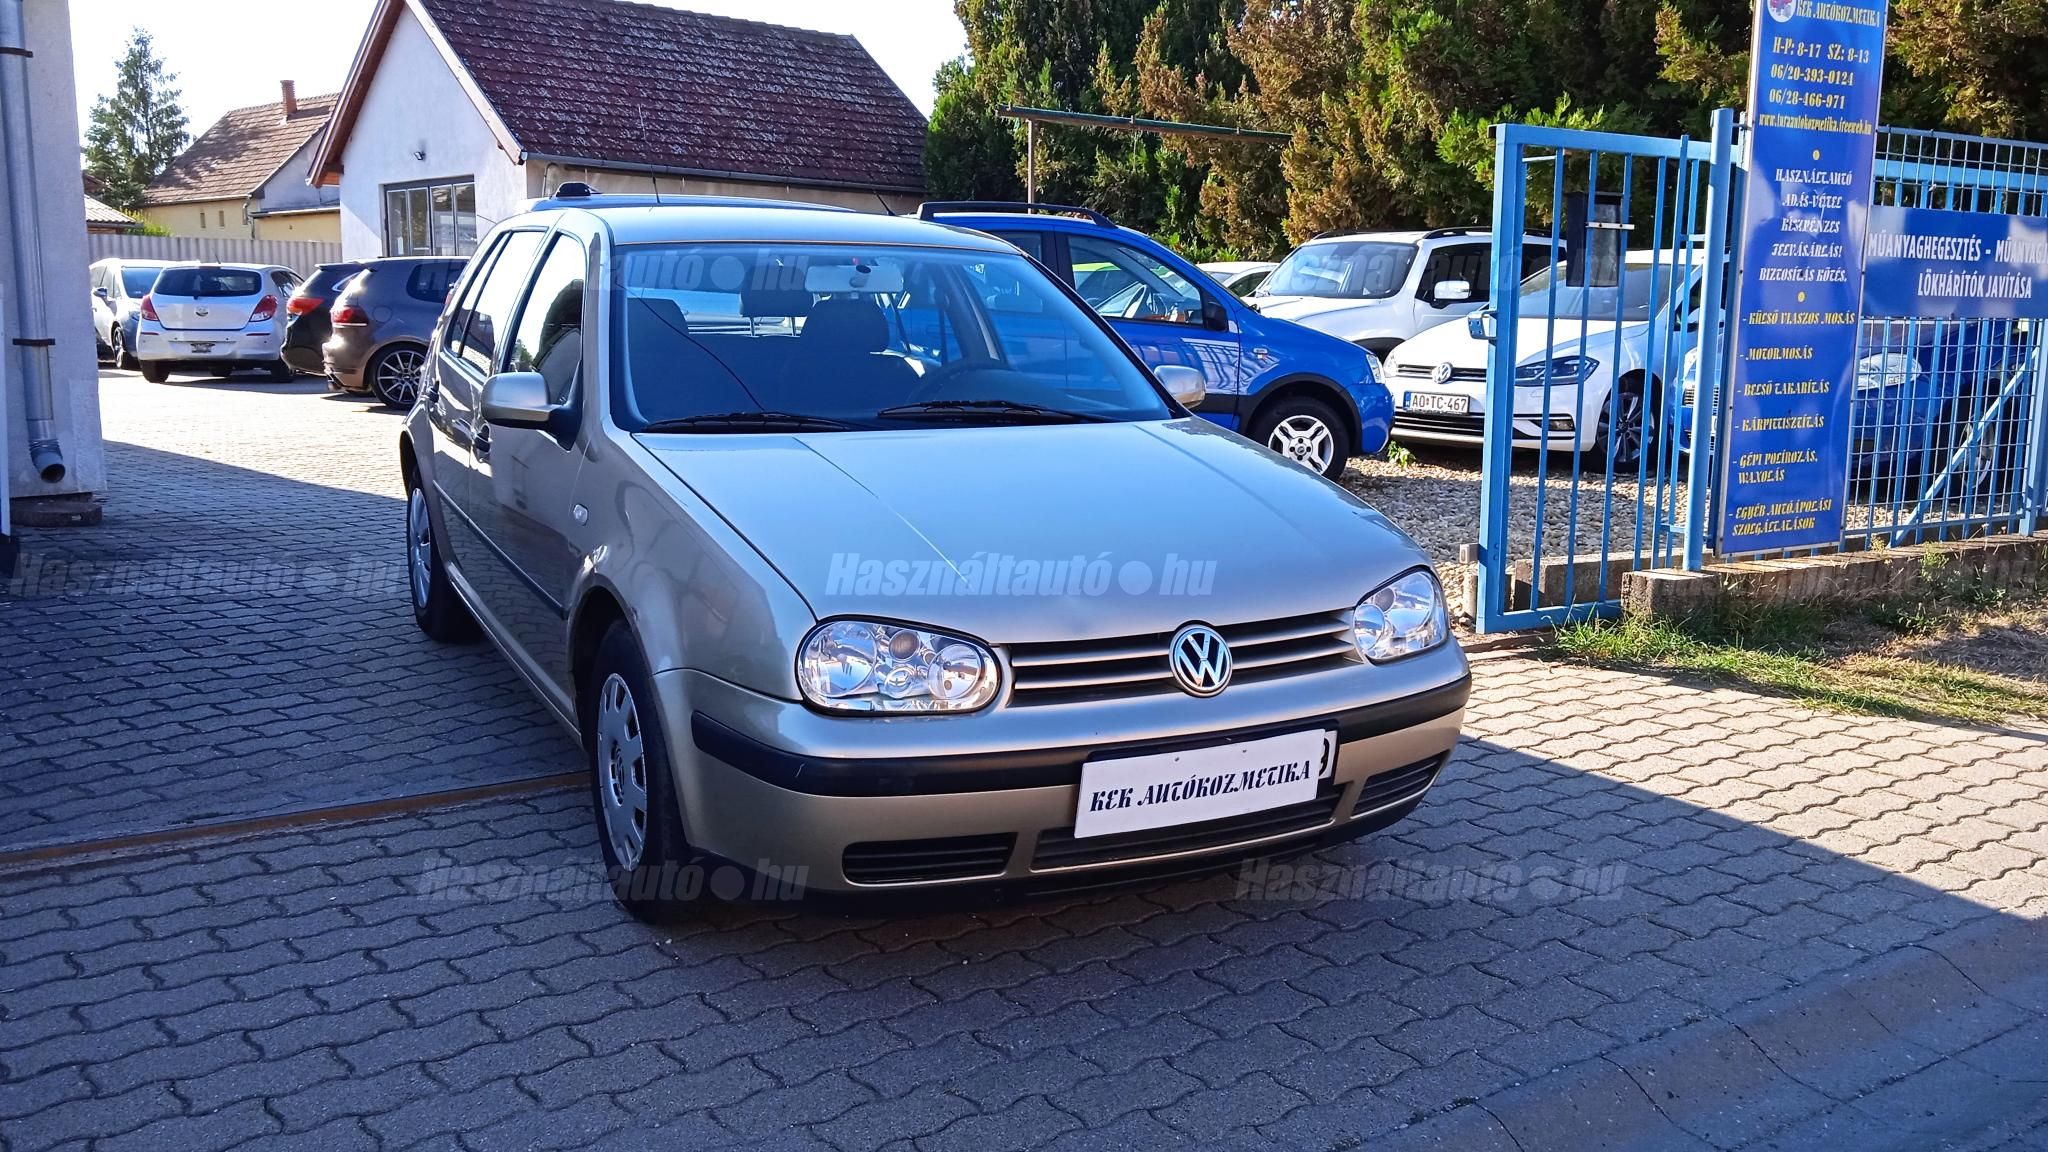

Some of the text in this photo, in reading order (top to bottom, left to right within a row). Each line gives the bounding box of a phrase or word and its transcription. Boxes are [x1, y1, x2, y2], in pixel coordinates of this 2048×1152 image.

[1772, 37, 1870, 63] H-P: 8-17 SZ: 8-13
[1771, 64, 1854, 86] 06/20-393-0124
[1769, 88, 1845, 109] 06/28-466-971
[1986, 272, 2032, 298] JAVÍTÁSA
[1740, 451, 1762, 468] GÉPI
[1735, 503, 1766, 520] EGYÉB
[1090, 760, 1311, 812] KEK AUTÓKOZMETIKA
